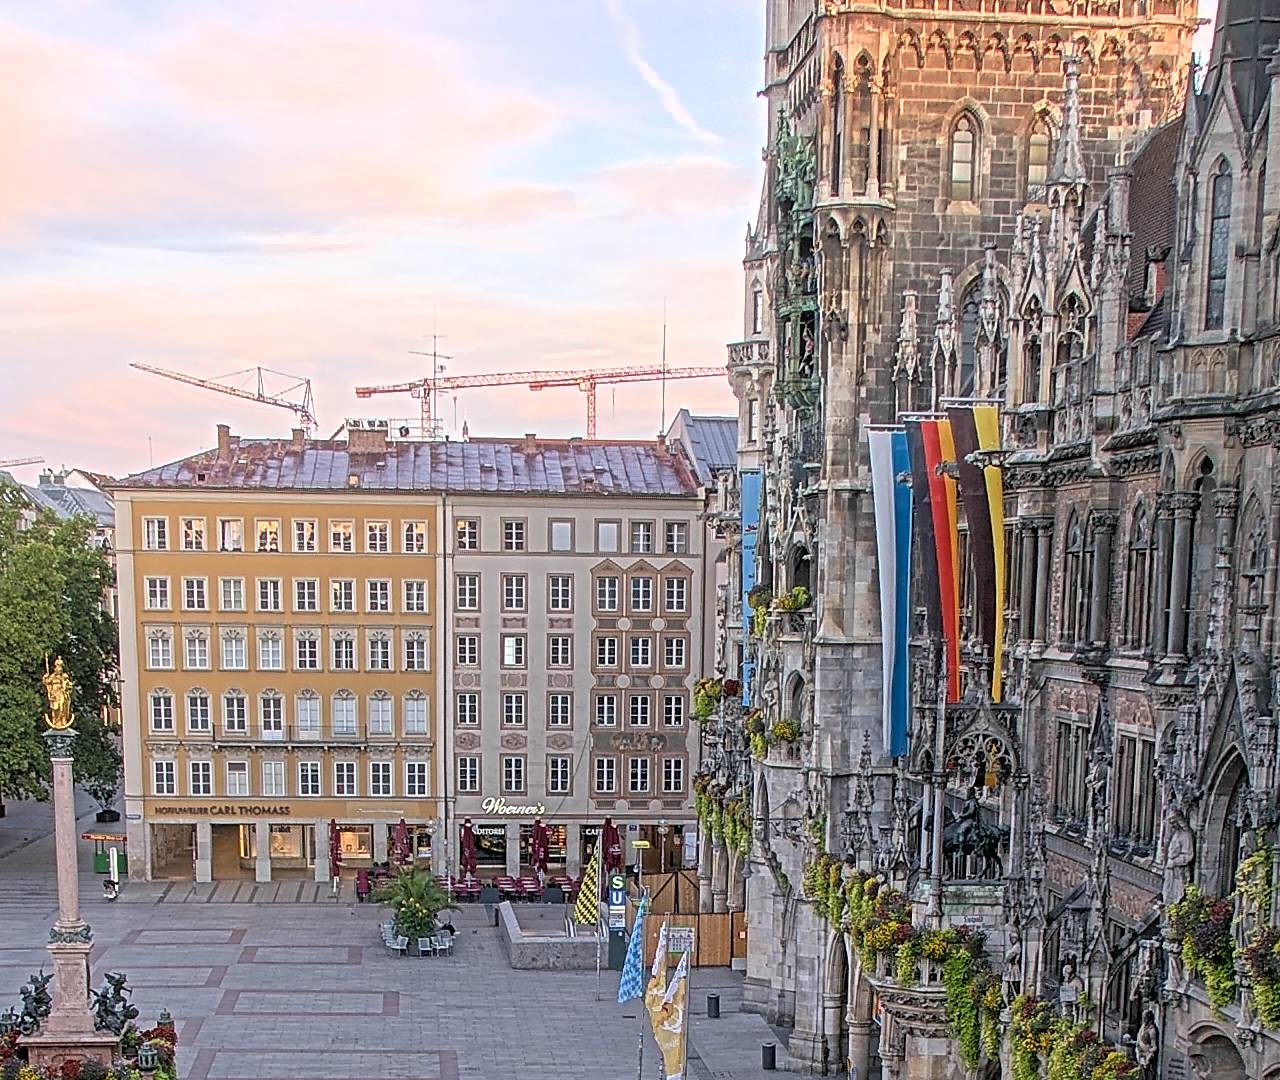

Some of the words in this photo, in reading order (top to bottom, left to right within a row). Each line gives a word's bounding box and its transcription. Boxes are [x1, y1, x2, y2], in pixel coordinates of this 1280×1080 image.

[209, 806, 236, 816] CARL
[237, 805, 291, 816] THOMASS
[481, 796, 546, 816] Woerner's
[612, 876, 624, 889] S
[612, 891, 623, 904] U
